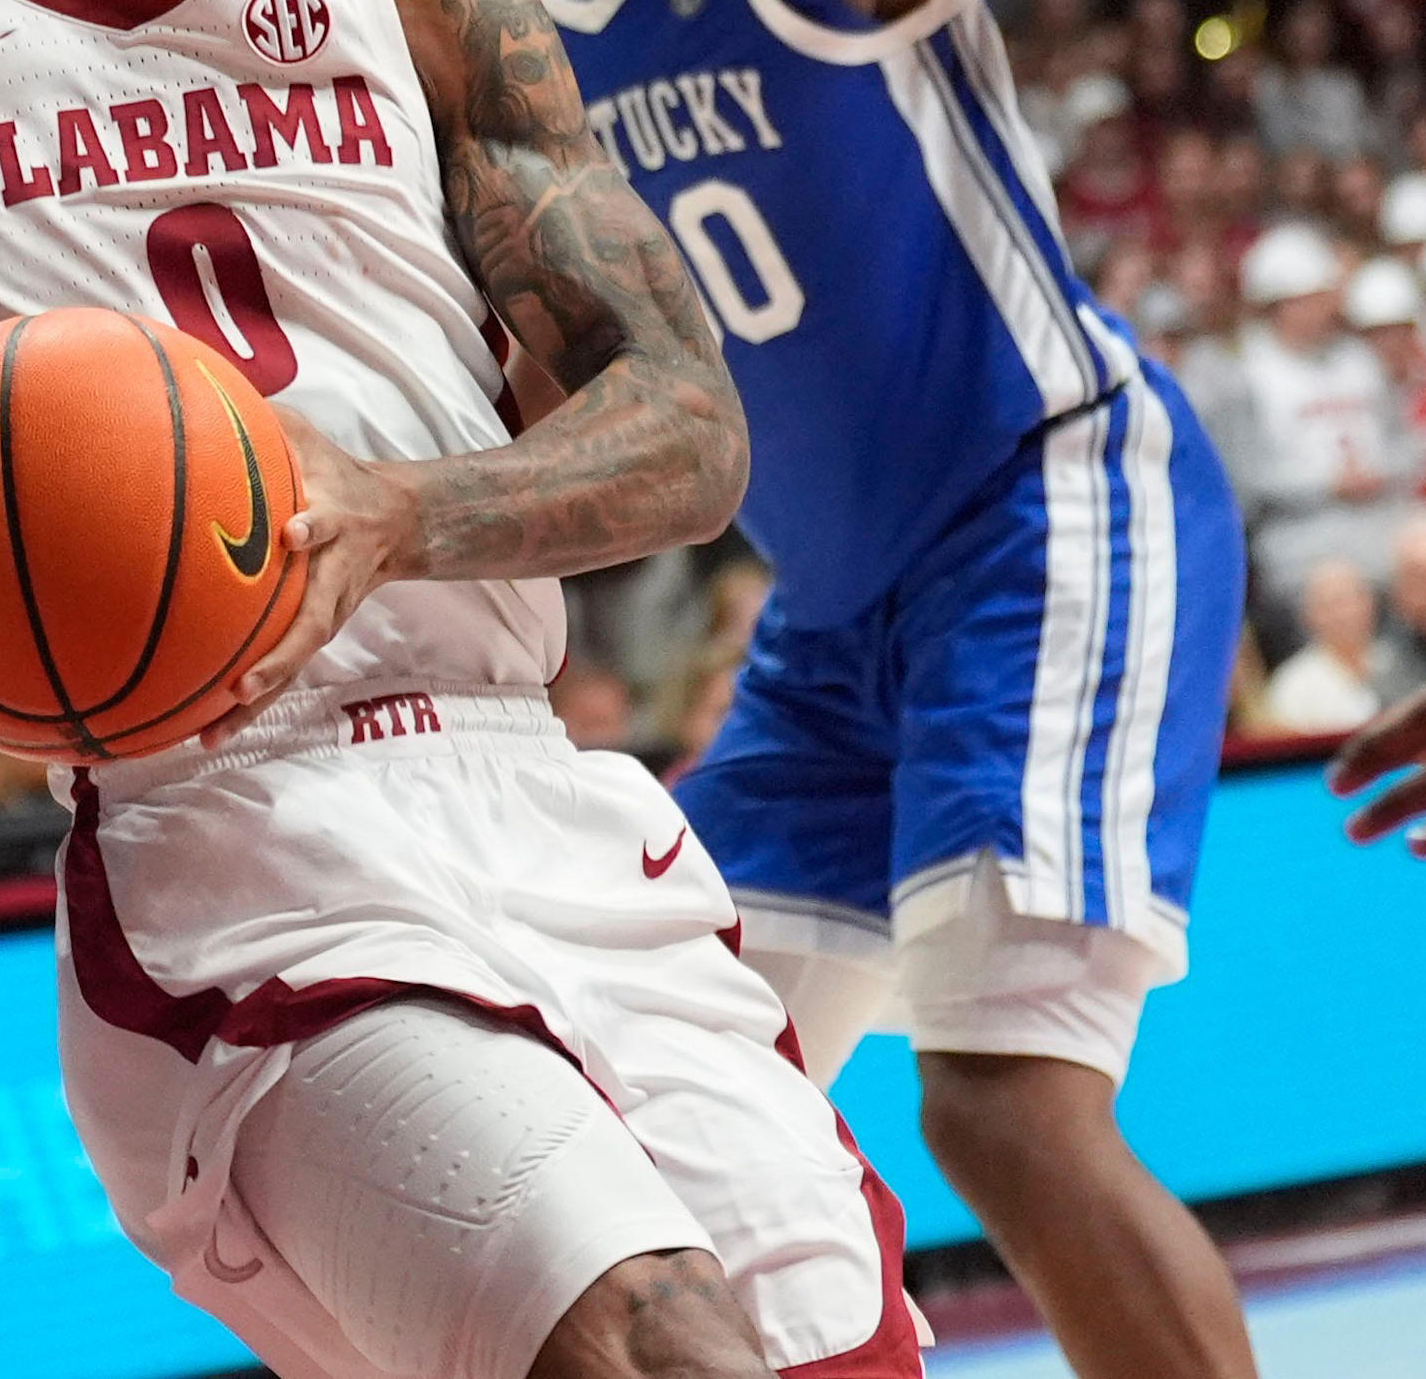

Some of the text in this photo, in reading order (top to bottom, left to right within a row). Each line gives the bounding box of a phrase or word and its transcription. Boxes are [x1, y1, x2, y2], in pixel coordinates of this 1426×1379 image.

[587, 70, 783, 181] TUCKY
[146, 202, 297, 397] 0
[670, 178, 806, 348] 0
[341, 692, 442, 744] RTR
